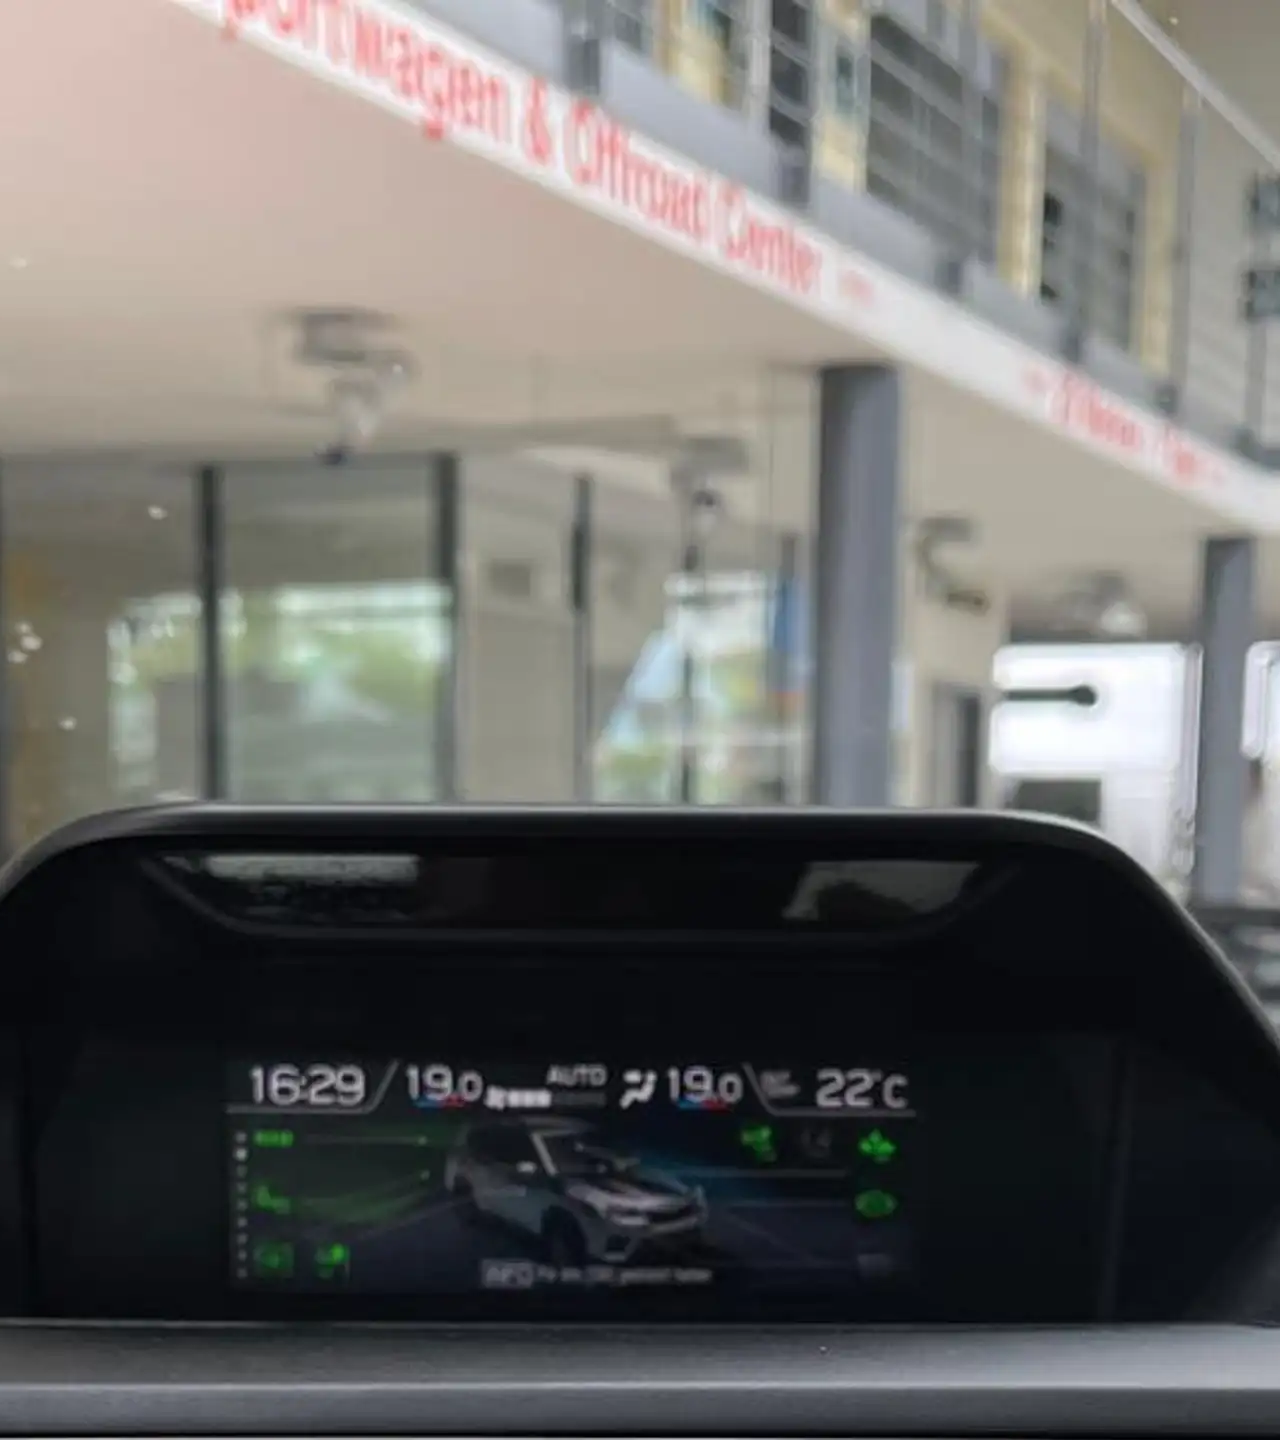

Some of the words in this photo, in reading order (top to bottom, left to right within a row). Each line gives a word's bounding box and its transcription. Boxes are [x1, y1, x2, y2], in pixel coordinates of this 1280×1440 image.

[524, 75, 554, 166] &
[718, 178, 822, 296] Center
[251, 1063, 366, 1106] 16:29
[546, 1064, 608, 1086] AUTO
